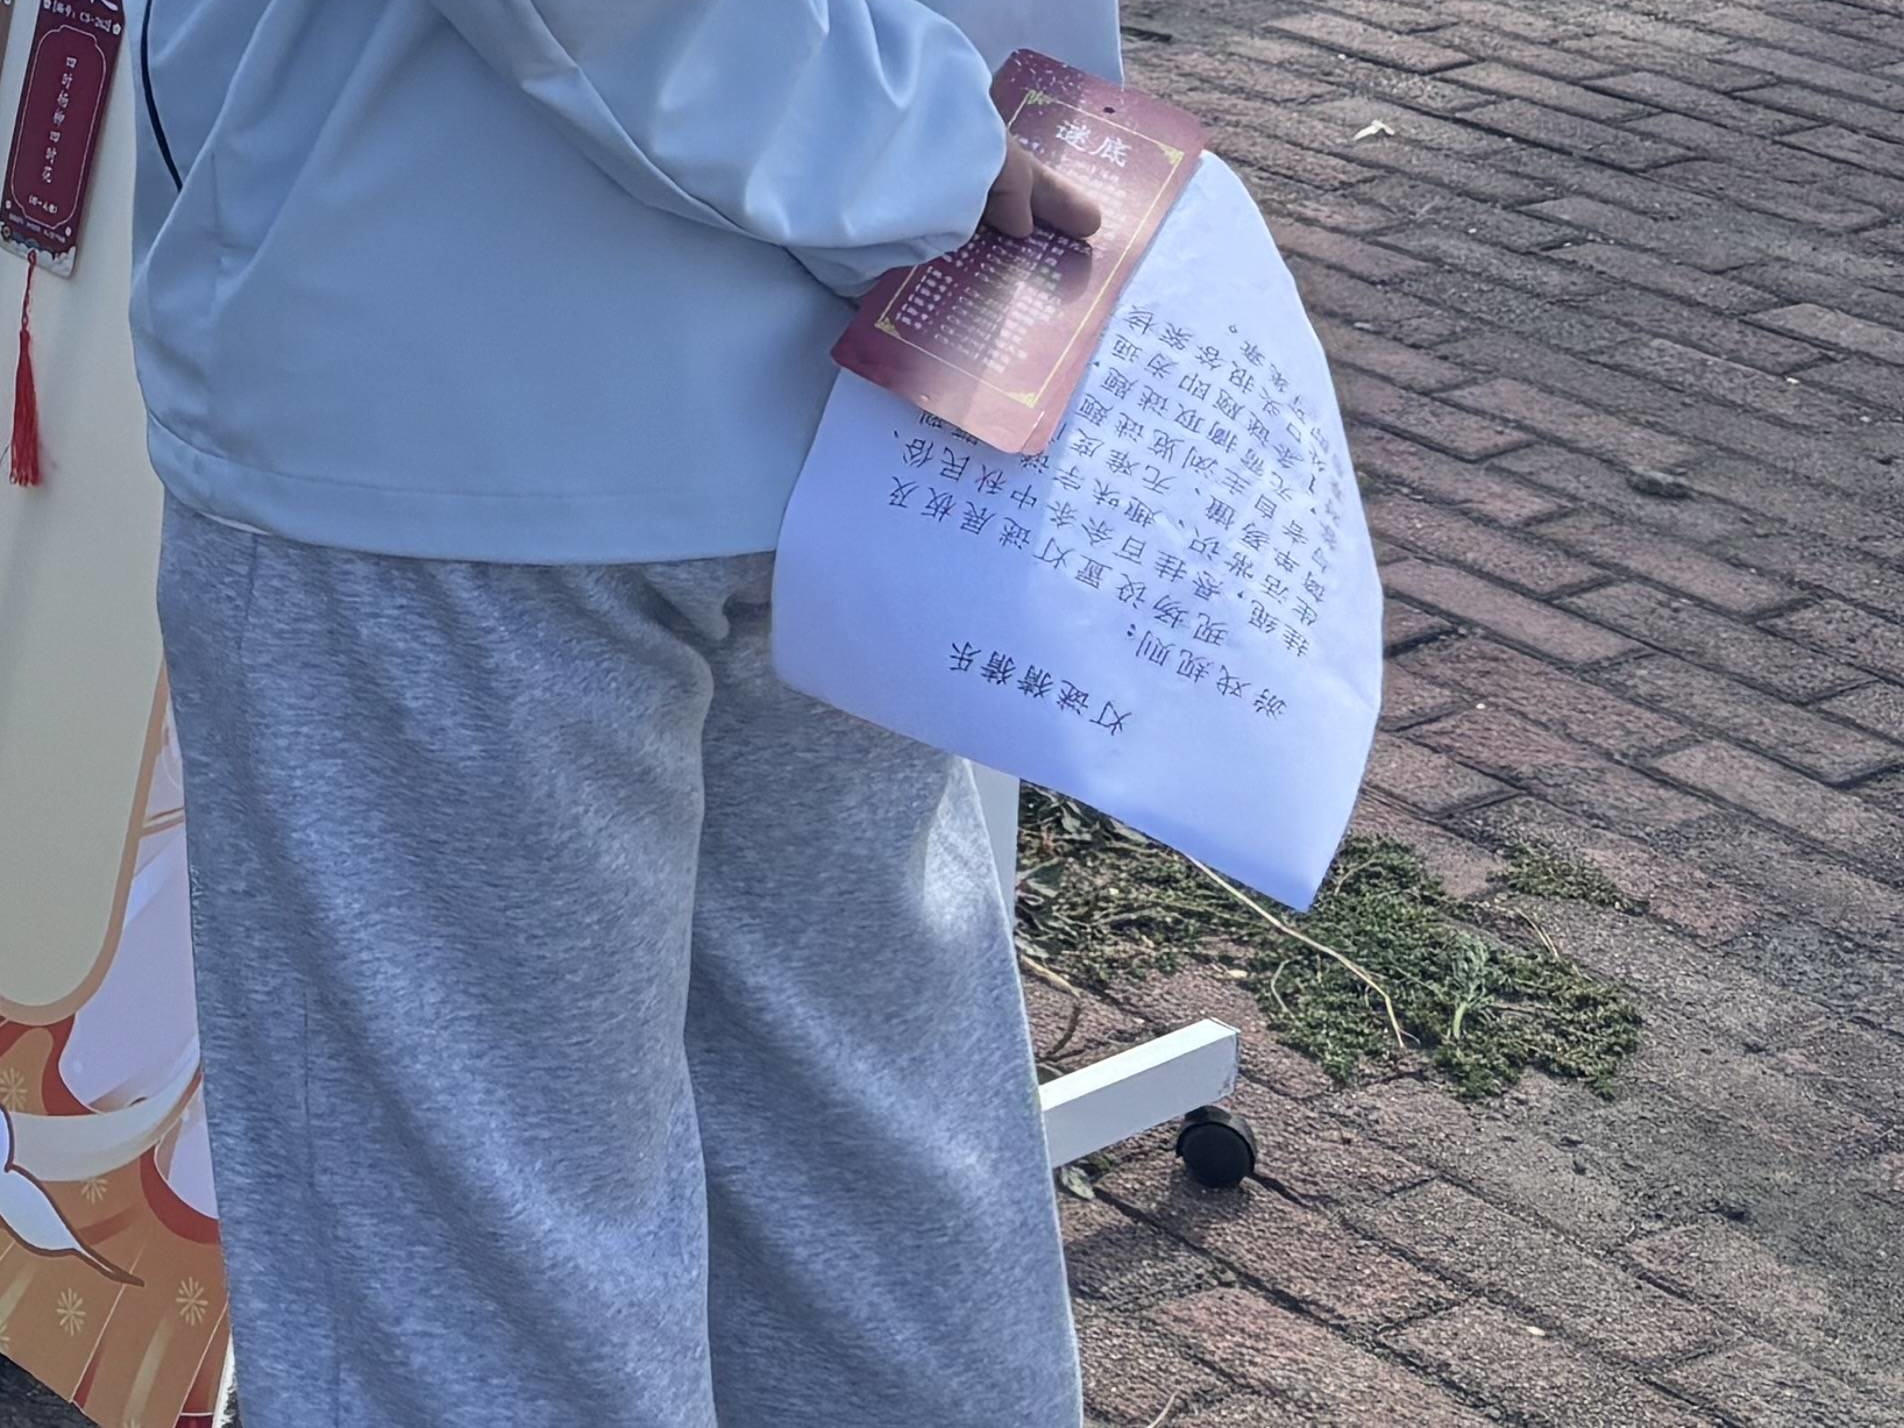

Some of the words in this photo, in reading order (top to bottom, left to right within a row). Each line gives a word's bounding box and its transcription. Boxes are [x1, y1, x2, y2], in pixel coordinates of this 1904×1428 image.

[1055, 119, 1130, 170] 谜底
[888, 476, 1228, 648] 现场设置灯谜展板及
[1052, 422, 1327, 600] 简单易懂、无难度
[948, 640, 1132, 736] 灯谜猜猜乐
